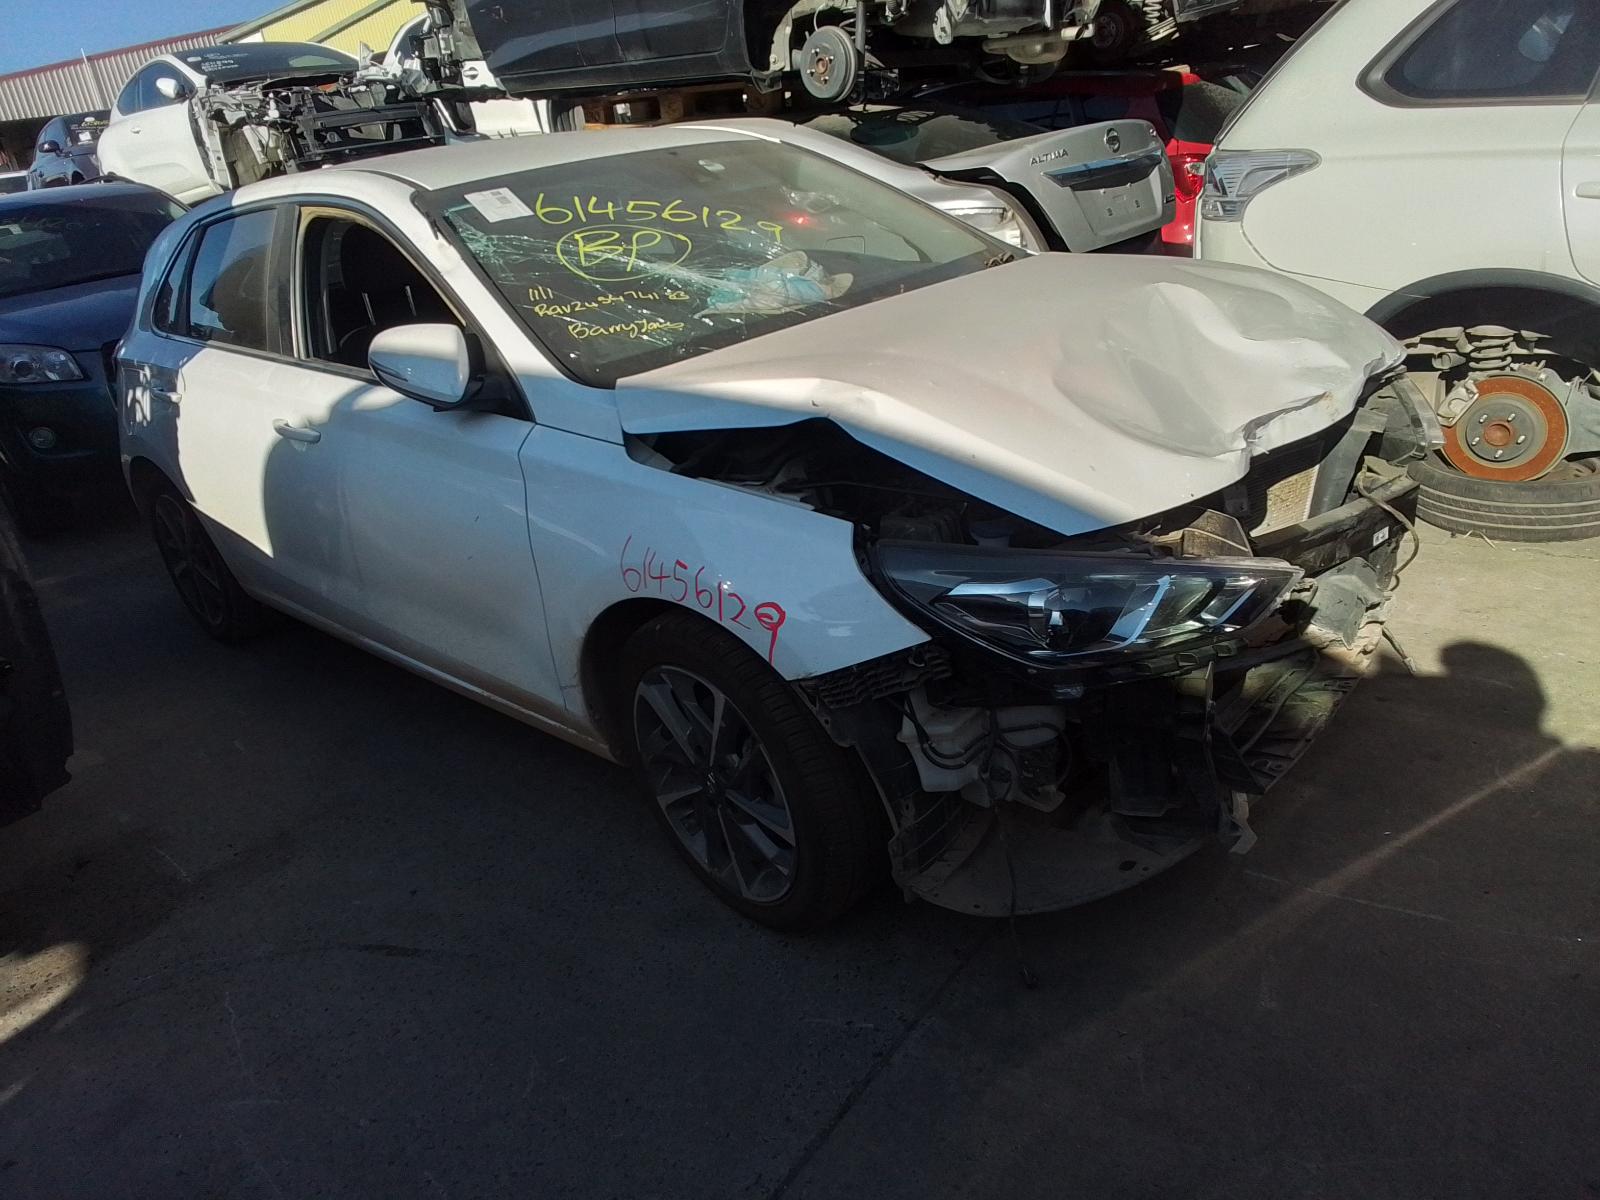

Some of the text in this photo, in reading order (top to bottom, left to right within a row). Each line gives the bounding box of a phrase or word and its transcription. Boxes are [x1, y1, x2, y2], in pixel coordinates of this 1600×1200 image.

[1030, 148, 1069, 166] ALTIMA
[535, 193, 784, 242] 61456129
[620, 535, 786, 666] 61456129
